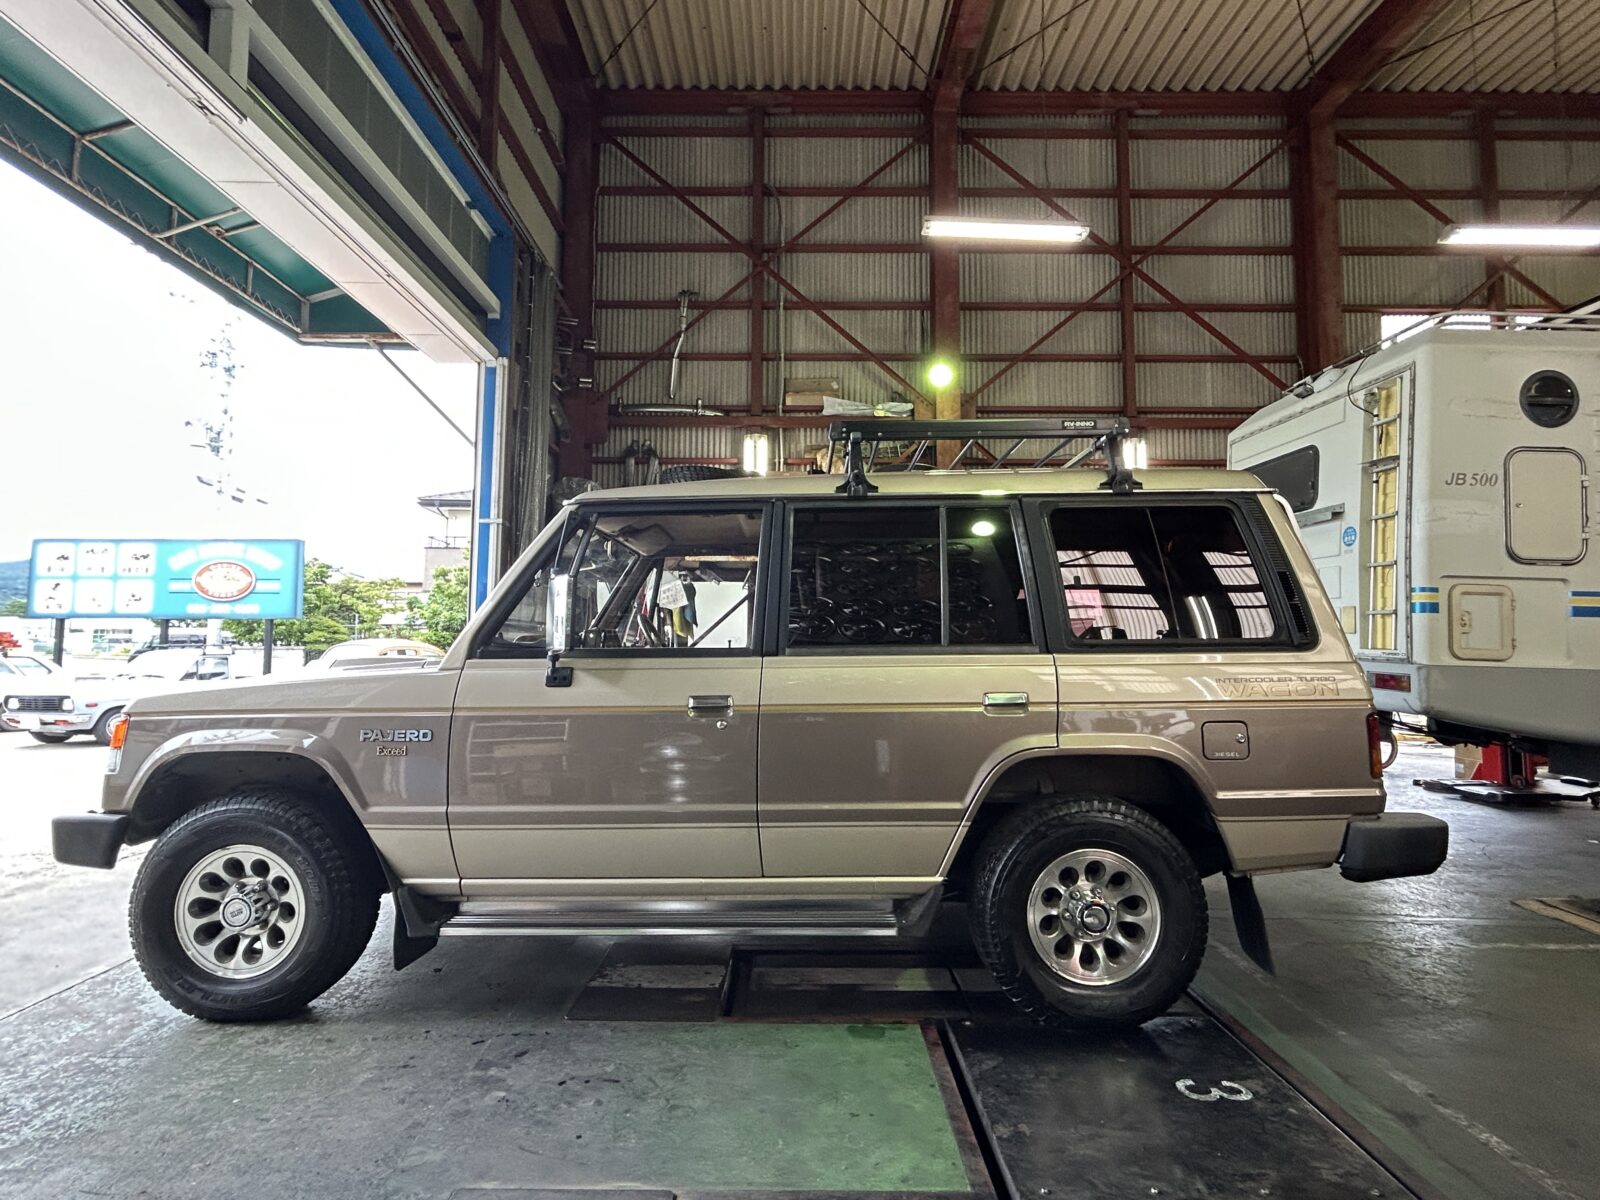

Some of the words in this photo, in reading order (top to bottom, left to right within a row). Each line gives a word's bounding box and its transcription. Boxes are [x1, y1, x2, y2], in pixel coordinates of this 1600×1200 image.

[1445, 472, 1467, 486] JB
[1469, 472, 1498, 487] 500
[1215, 676, 1293, 684] INTERCOOLER
[1219, 682, 1340, 698] WAGON
[359, 728, 433, 742] PAJERO
[376, 745, 408, 756] Exceed
